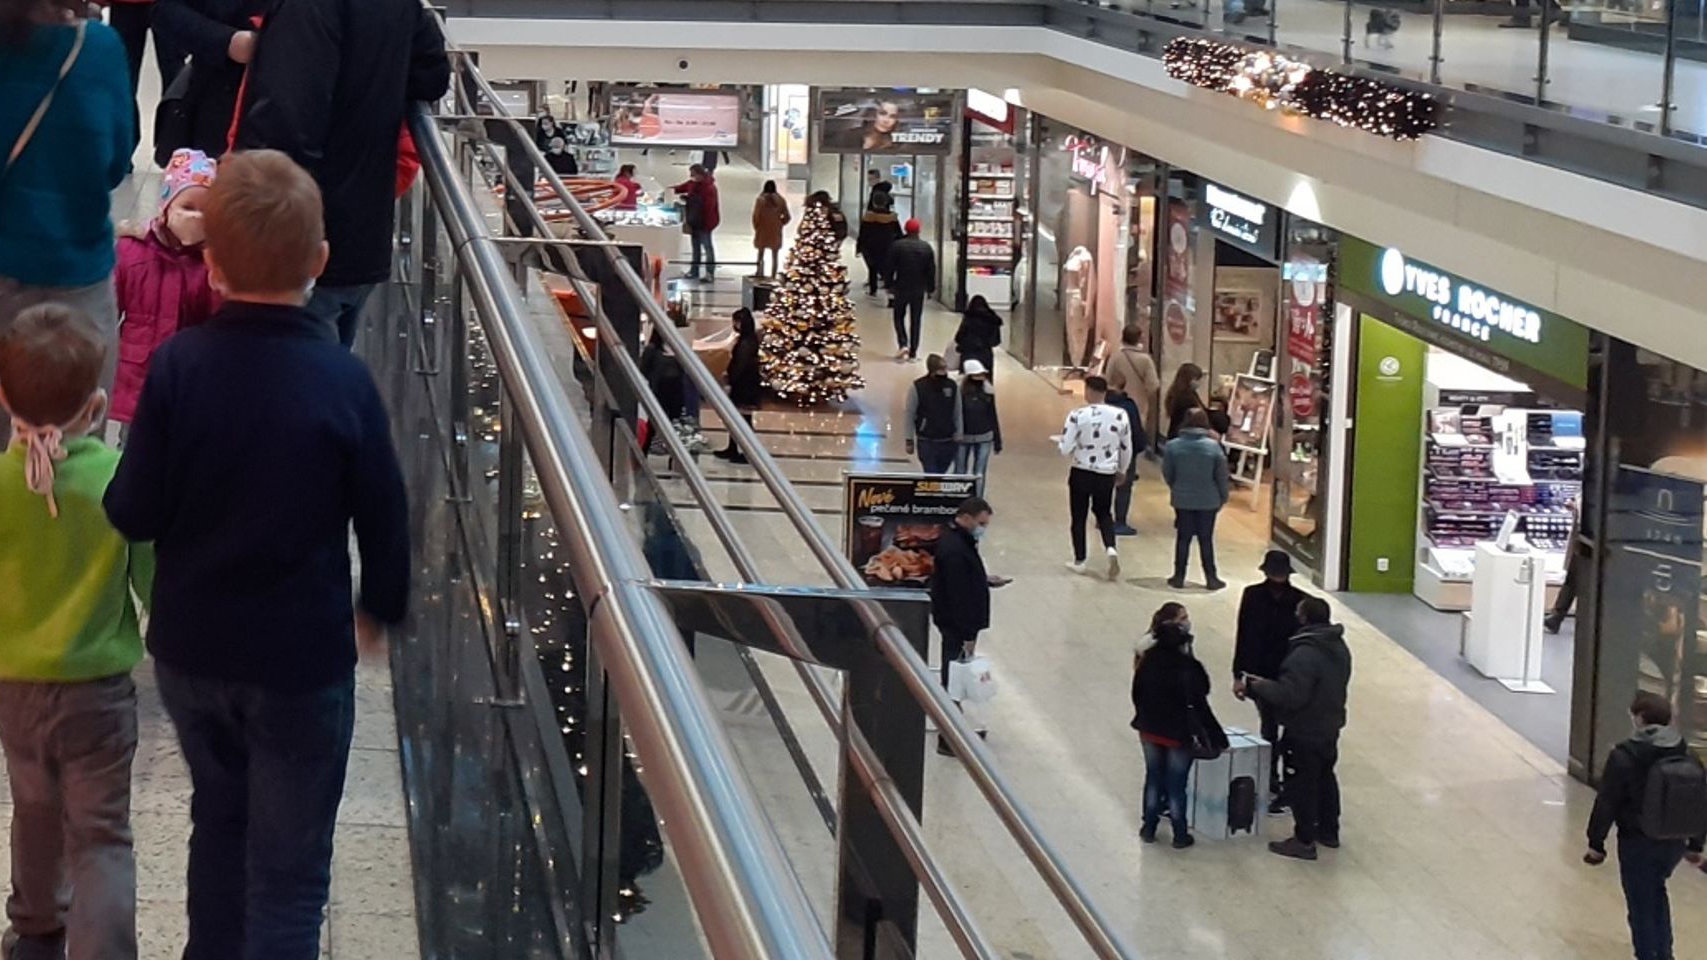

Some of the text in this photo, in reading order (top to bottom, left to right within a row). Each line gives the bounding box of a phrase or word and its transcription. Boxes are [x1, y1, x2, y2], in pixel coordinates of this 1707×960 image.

[891, 132, 945, 144] TRENDY
[1404, 263, 1451, 305] YVES
[1458, 285, 1542, 343] ROCHER
[1432, 305, 1491, 341] FRANCE
[915, 481, 973, 493] SUBWAY
[858, 487, 895, 508] Nové
[870, 503, 960, 515] pečené brambor
